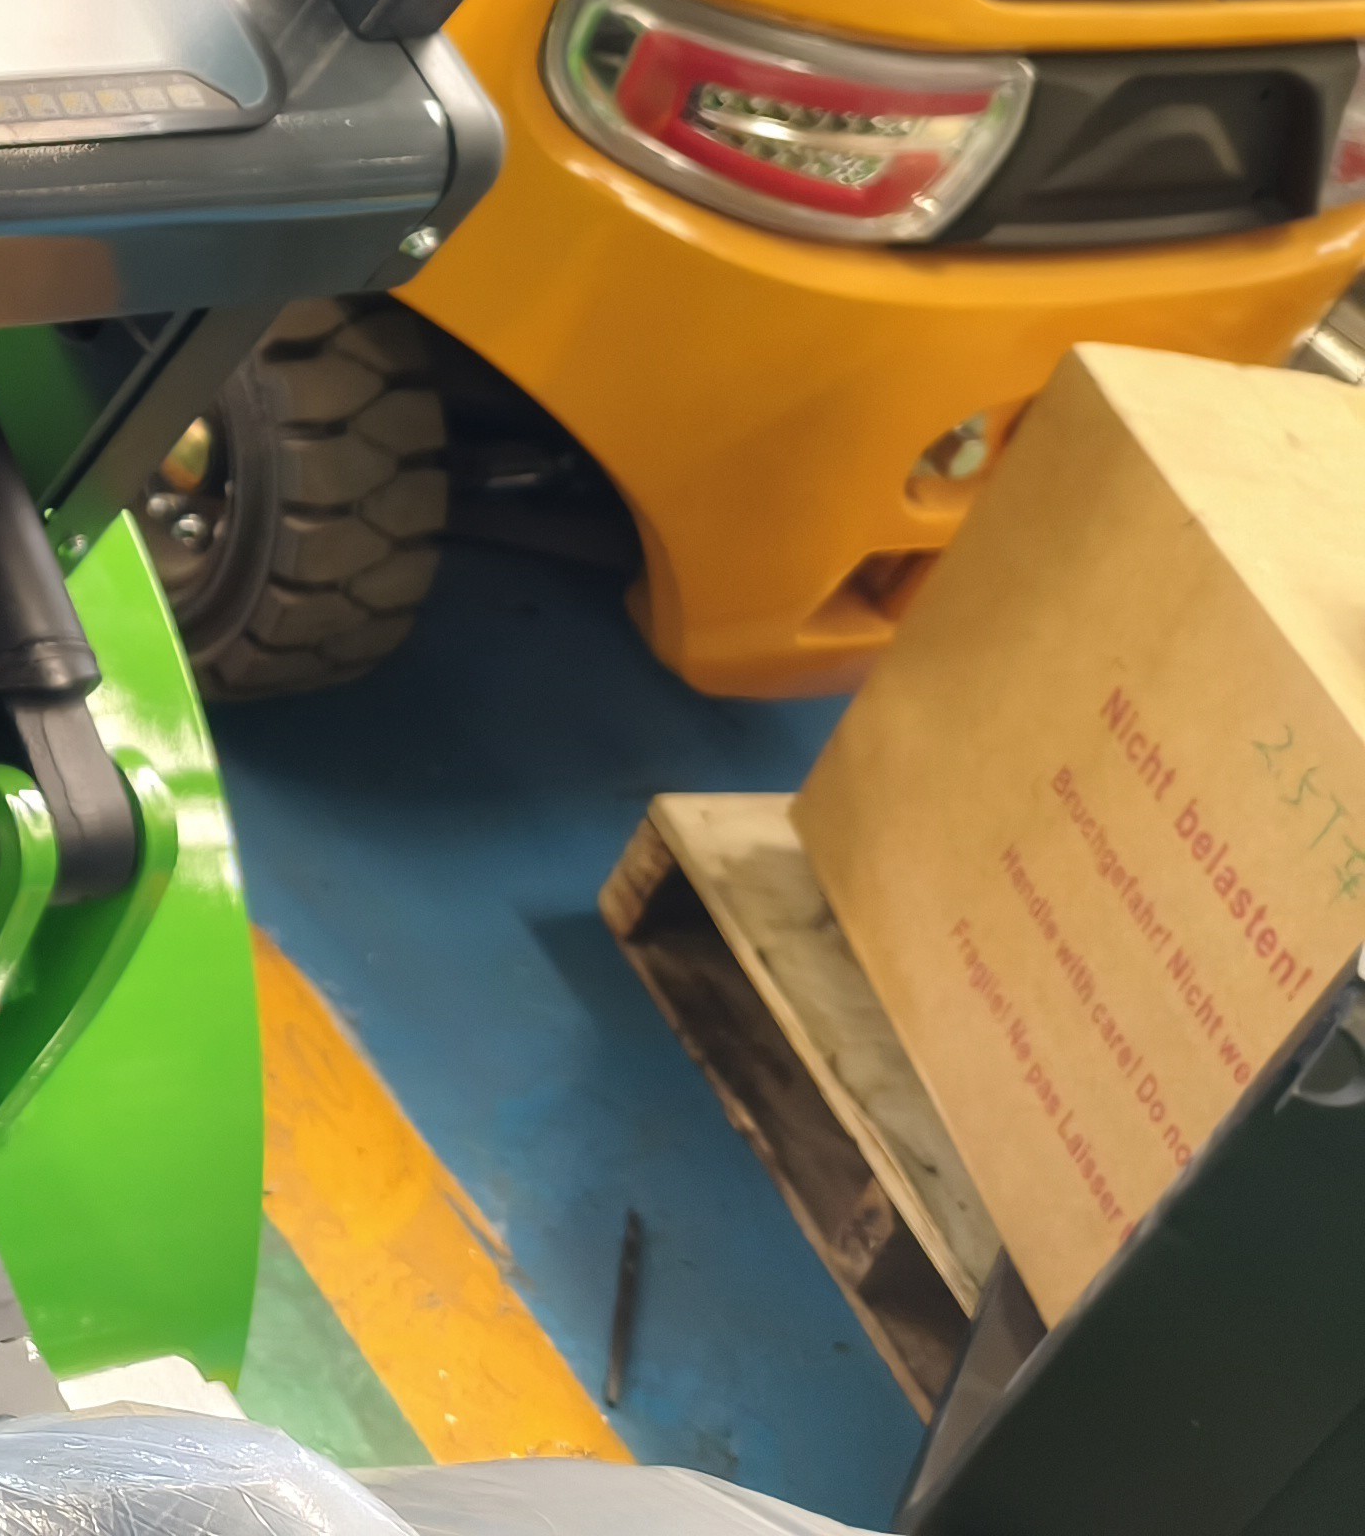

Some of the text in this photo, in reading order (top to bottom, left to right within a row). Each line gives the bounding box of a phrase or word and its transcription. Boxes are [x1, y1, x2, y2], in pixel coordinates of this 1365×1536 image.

[1100, 686, 1313, 1001] Nicht belasten!
[1001, 842, 1058, 940] Handle
[1056, 939, 1095, 1005] with
[1136, 1073, 1166, 1123] Do
[1162, 1124, 1194, 1167] no
[1023, 1063, 1060, 1118] pas
[1166, 945, 1223, 1039] Nicht
[1219, 1036, 1252, 1085] we
